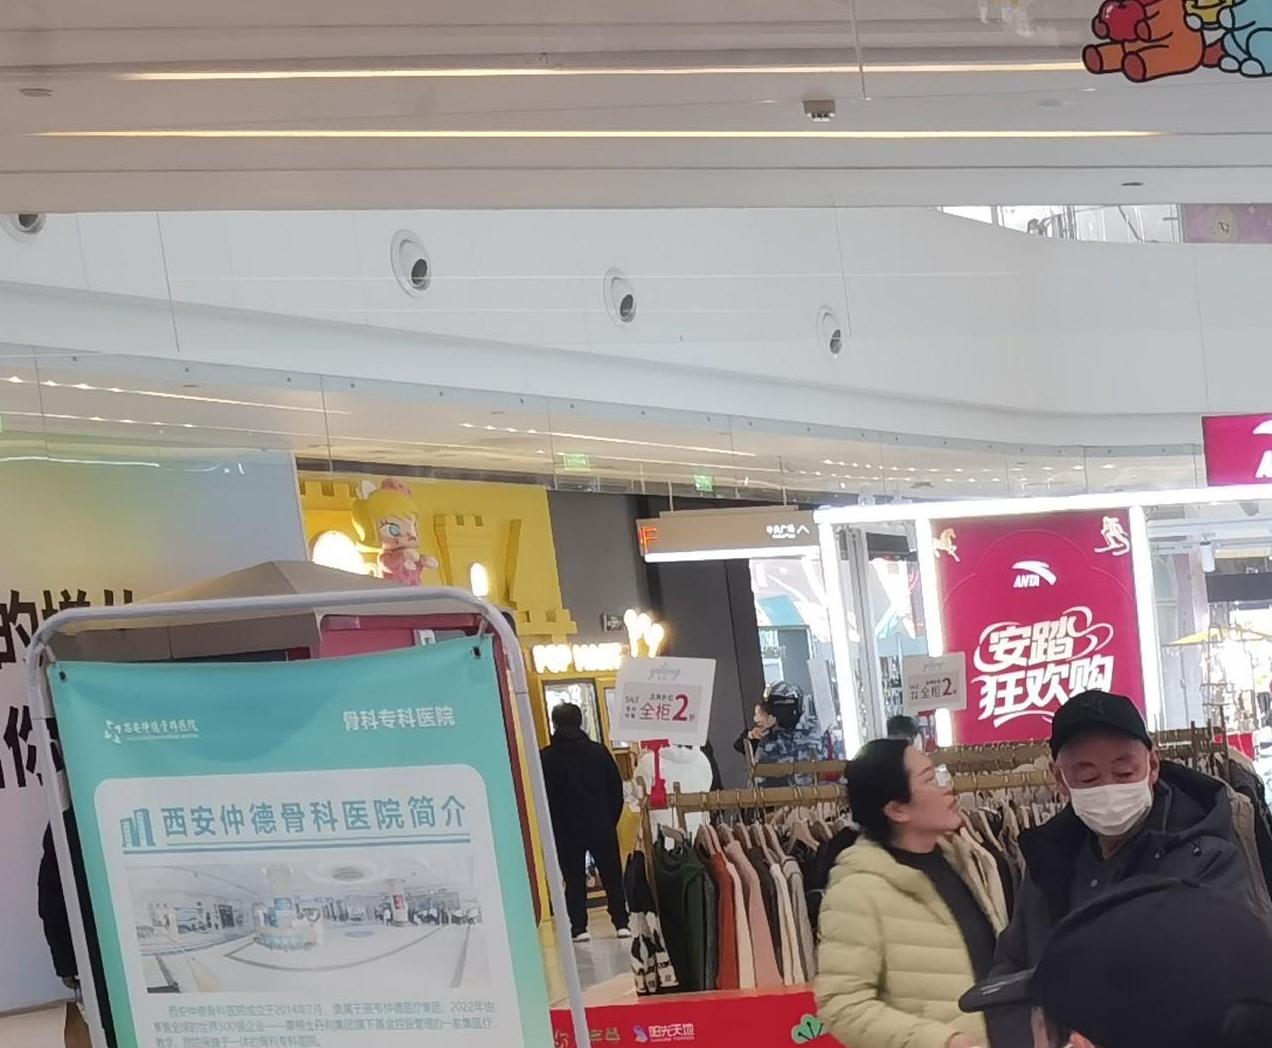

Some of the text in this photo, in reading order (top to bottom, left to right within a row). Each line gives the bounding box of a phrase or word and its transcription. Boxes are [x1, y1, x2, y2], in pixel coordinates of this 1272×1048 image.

[1013, 574, 1041, 589] ANTA
[981, 612, 1095, 667] 安踏
[343, 705, 456, 732] 骨科专科医院
[160, 794, 467, 838] 西安仲德骨科医院简介
